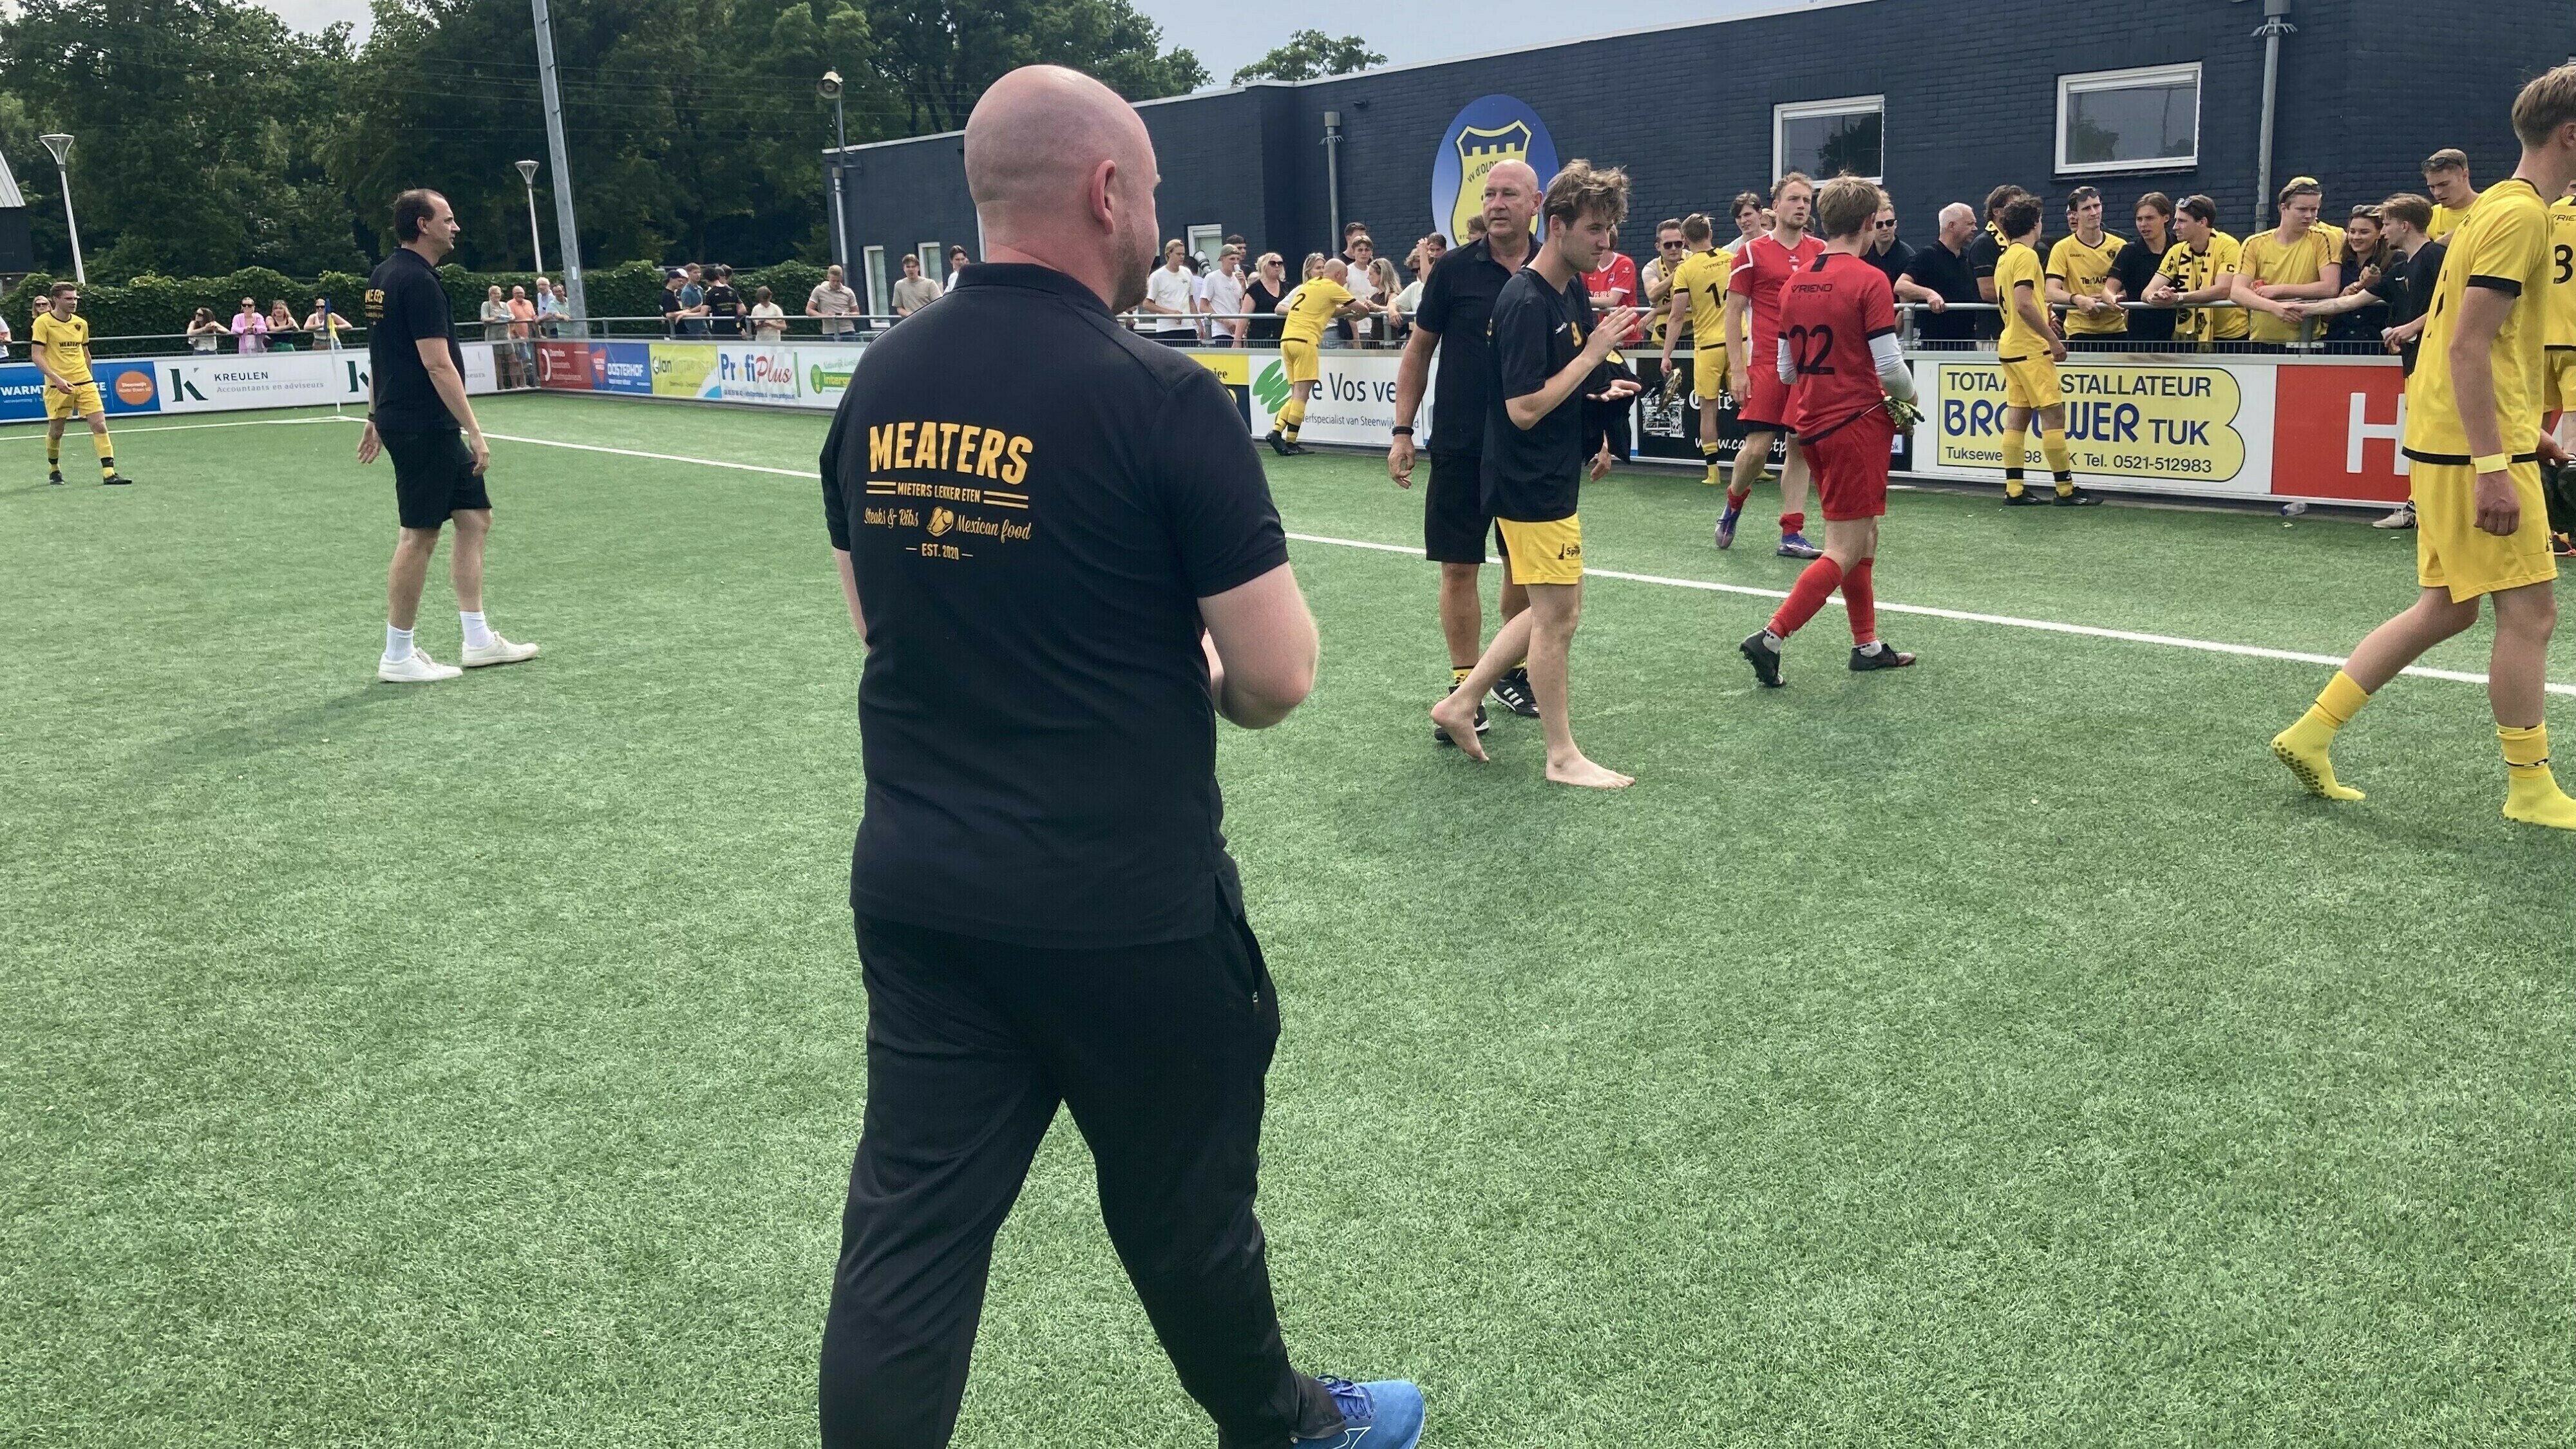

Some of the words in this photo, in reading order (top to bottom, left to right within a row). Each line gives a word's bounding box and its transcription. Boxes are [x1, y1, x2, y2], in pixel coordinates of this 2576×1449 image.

[2226, 263, 2235, 272] C
[1791, 283, 1833, 294] VRIEND
[1290, 292, 1306, 311] 2
[1788, 324, 1835, 375] 22
[214, 371, 269, 382] KREULEN
[607, 363, 643, 377] OOSTERHOF
[216, 385, 270, 393] Accountants
[285, 381, 324, 390] adviseurs
[1329, 372, 1367, 403] Vos
[1372, 380, 1397, 404] ve
[2059, 373, 2212, 398] STALLATEUR
[1689, 388, 1734, 410] Cfé
[2148, 419, 2211, 446] TUK
[869, 421, 1034, 485] MEATERS
[1945, 446, 2003, 462] Tuksewe
[2083, 452, 2107, 468] Tel.
[2113, 454, 2212, 474] 0521-512983
[897, 482, 933, 498] MIETERS
[934, 485, 961, 502] LEKKER
[961, 488, 981, 503] ETEN
[864, 507, 886, 525] Steaks
[887, 507, 897, 529] &
[899, 509, 920, 527] Ribs
[956, 515, 999, 537] Mexican
[999, 519, 1032, 544] food
[921, 543, 942, 558] EST.
[942, 544, 960, 561] 2020
